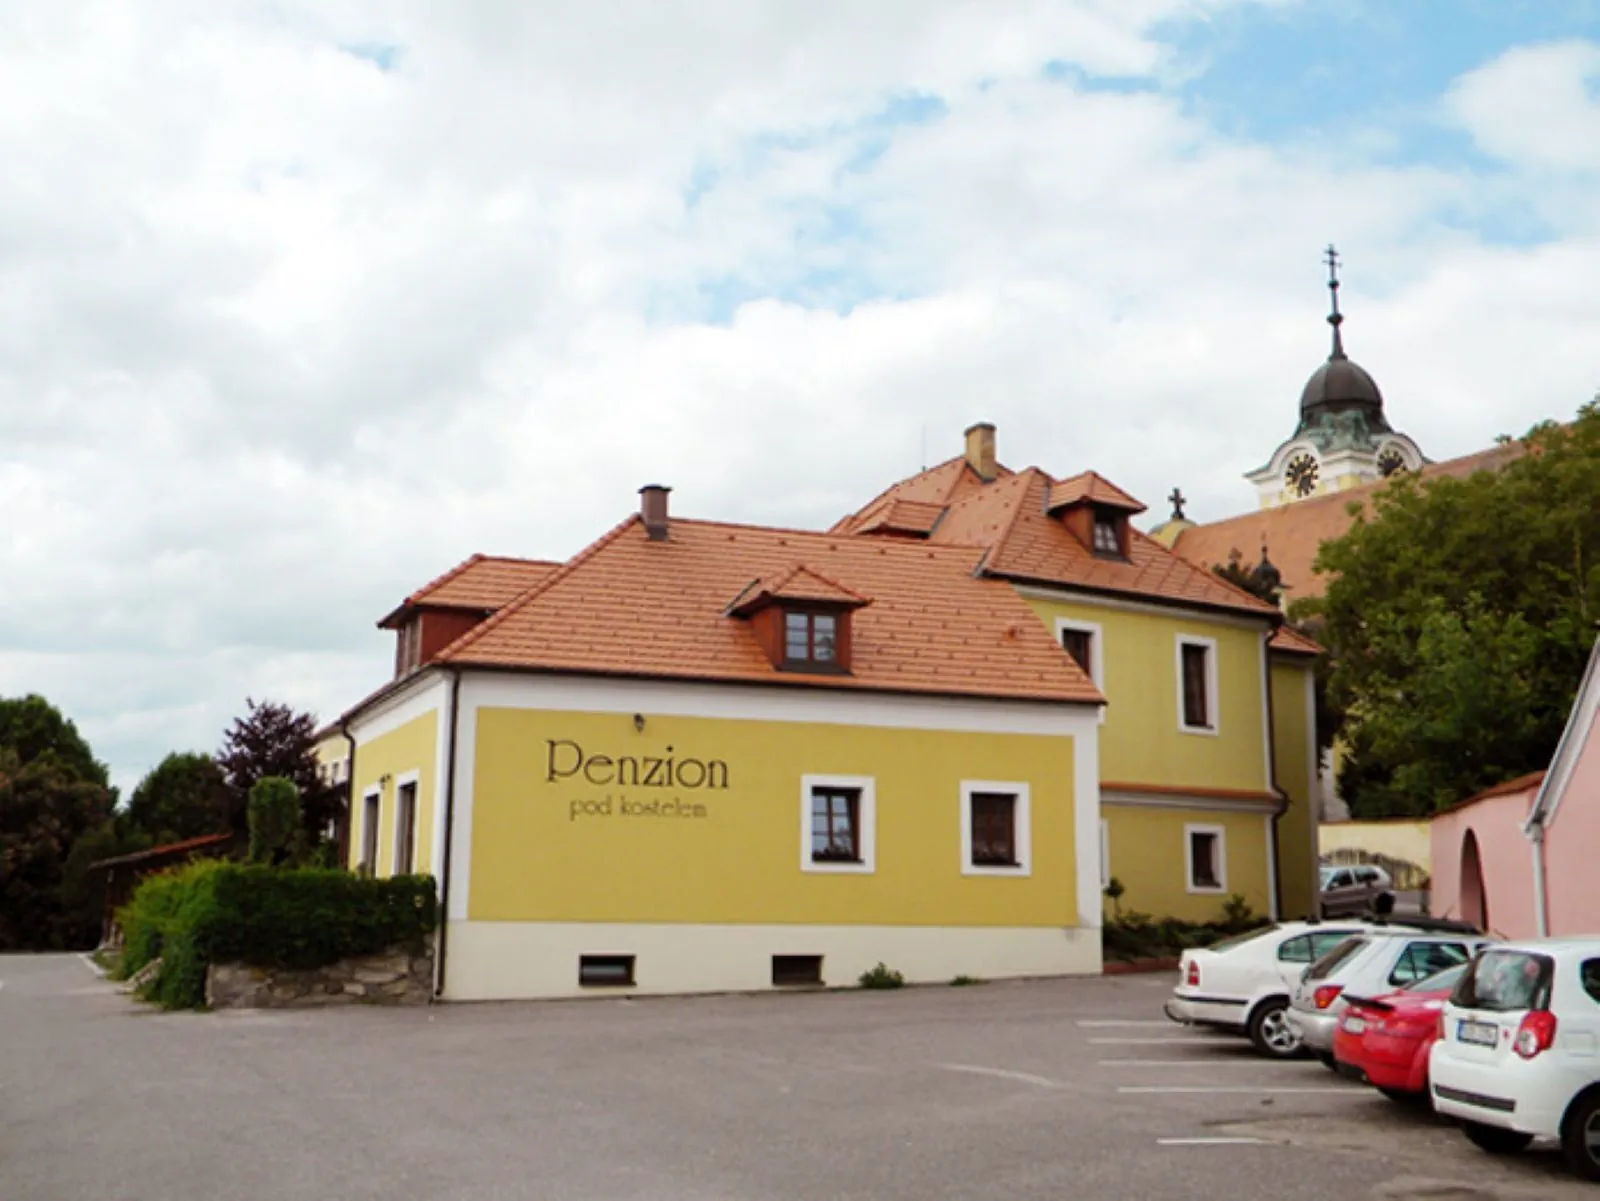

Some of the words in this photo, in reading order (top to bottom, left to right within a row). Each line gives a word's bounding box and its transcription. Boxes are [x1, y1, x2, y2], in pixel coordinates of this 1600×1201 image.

[546, 739, 729, 788] Penzion
[569, 795, 612, 821] pod
[620, 796, 708, 818] kostelem
